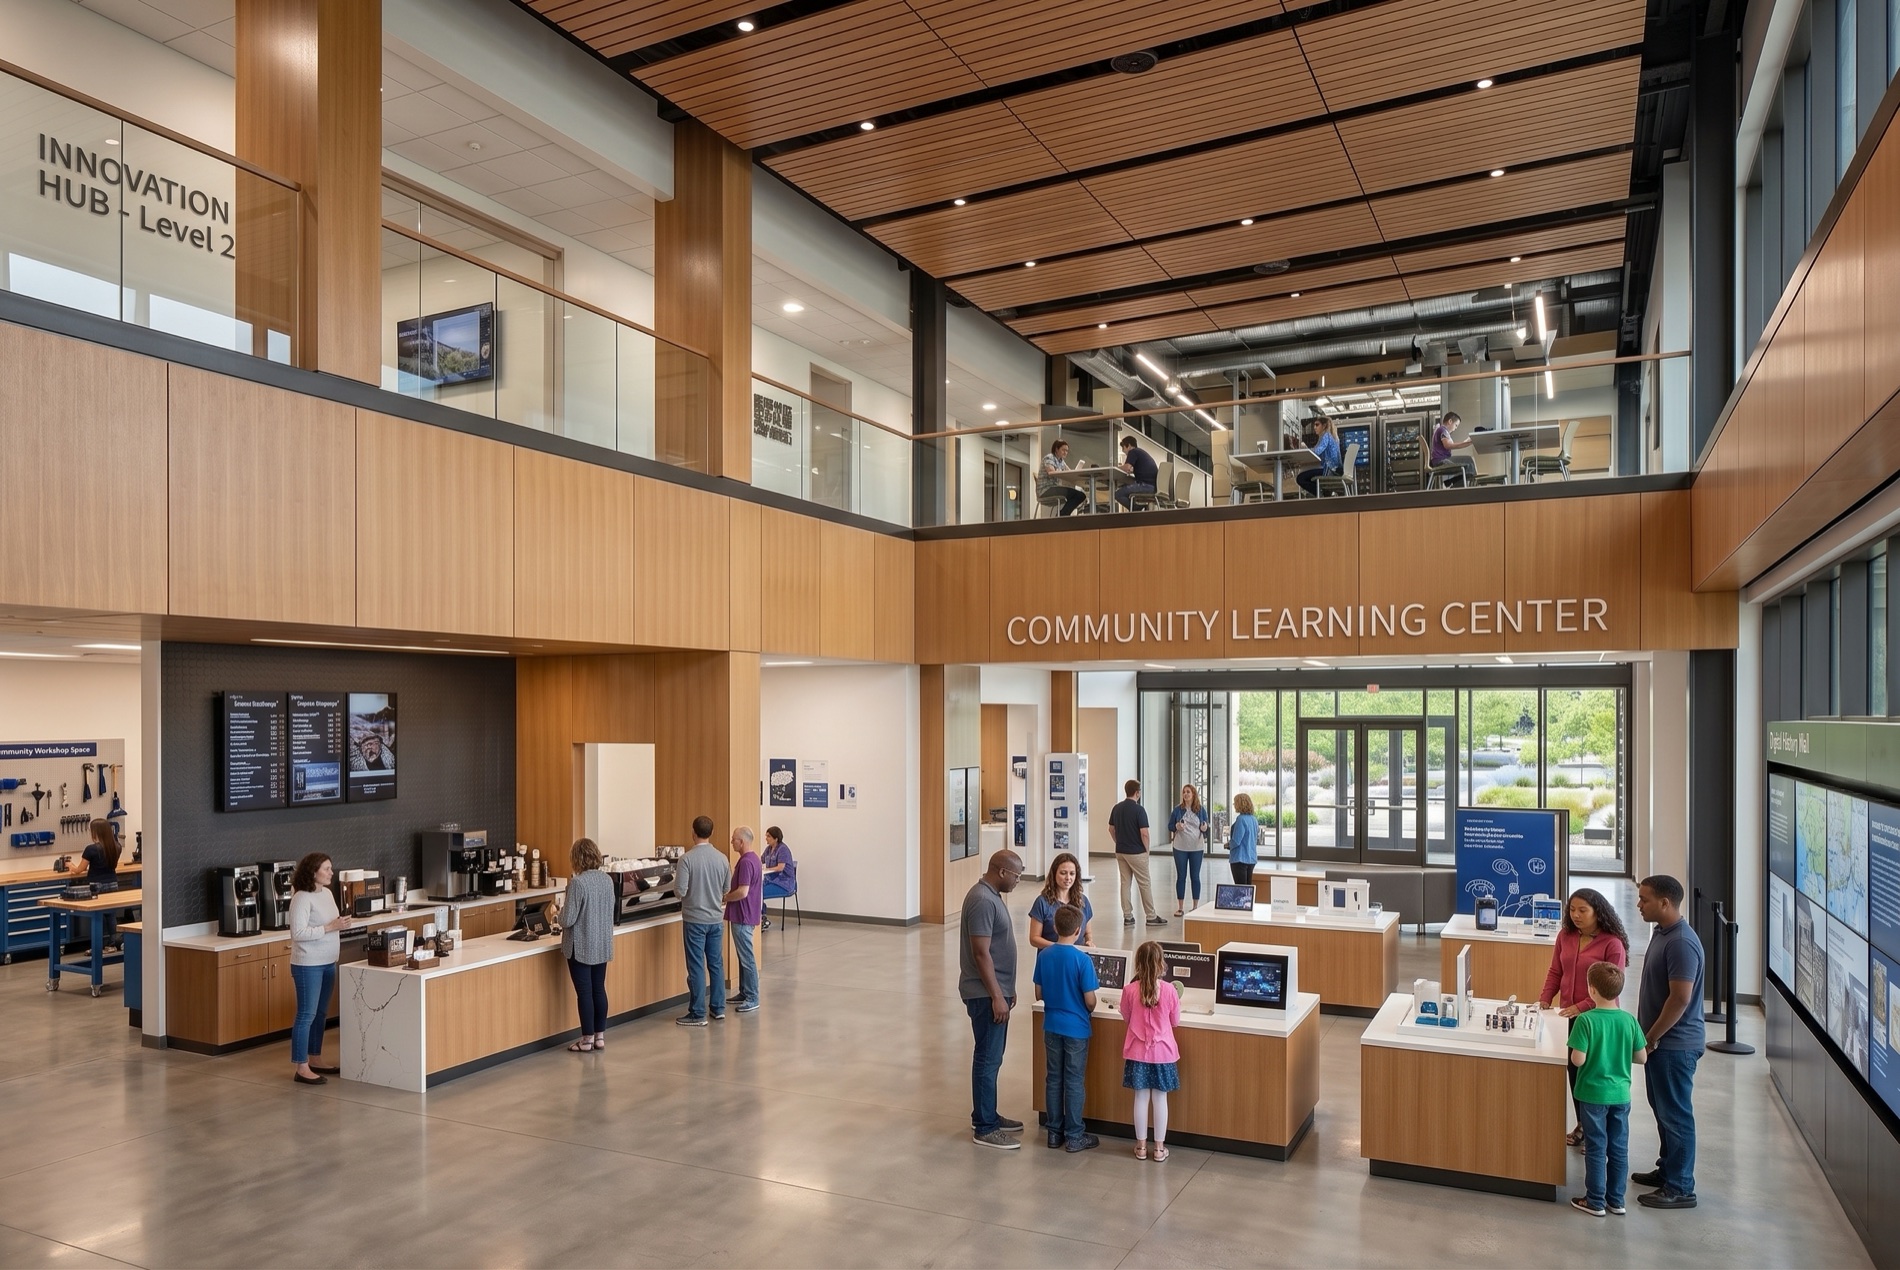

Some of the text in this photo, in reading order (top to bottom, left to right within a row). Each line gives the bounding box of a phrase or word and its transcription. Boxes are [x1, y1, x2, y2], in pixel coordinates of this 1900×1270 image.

[39, 133, 229, 224] INNOVATION
[39, 169, 235, 259] HUB - Level 2
[1007, 598, 1608, 645] COMMUNITY LEARNING CENTER
[0, 746, 90, 757] mmunity Workshop Space
